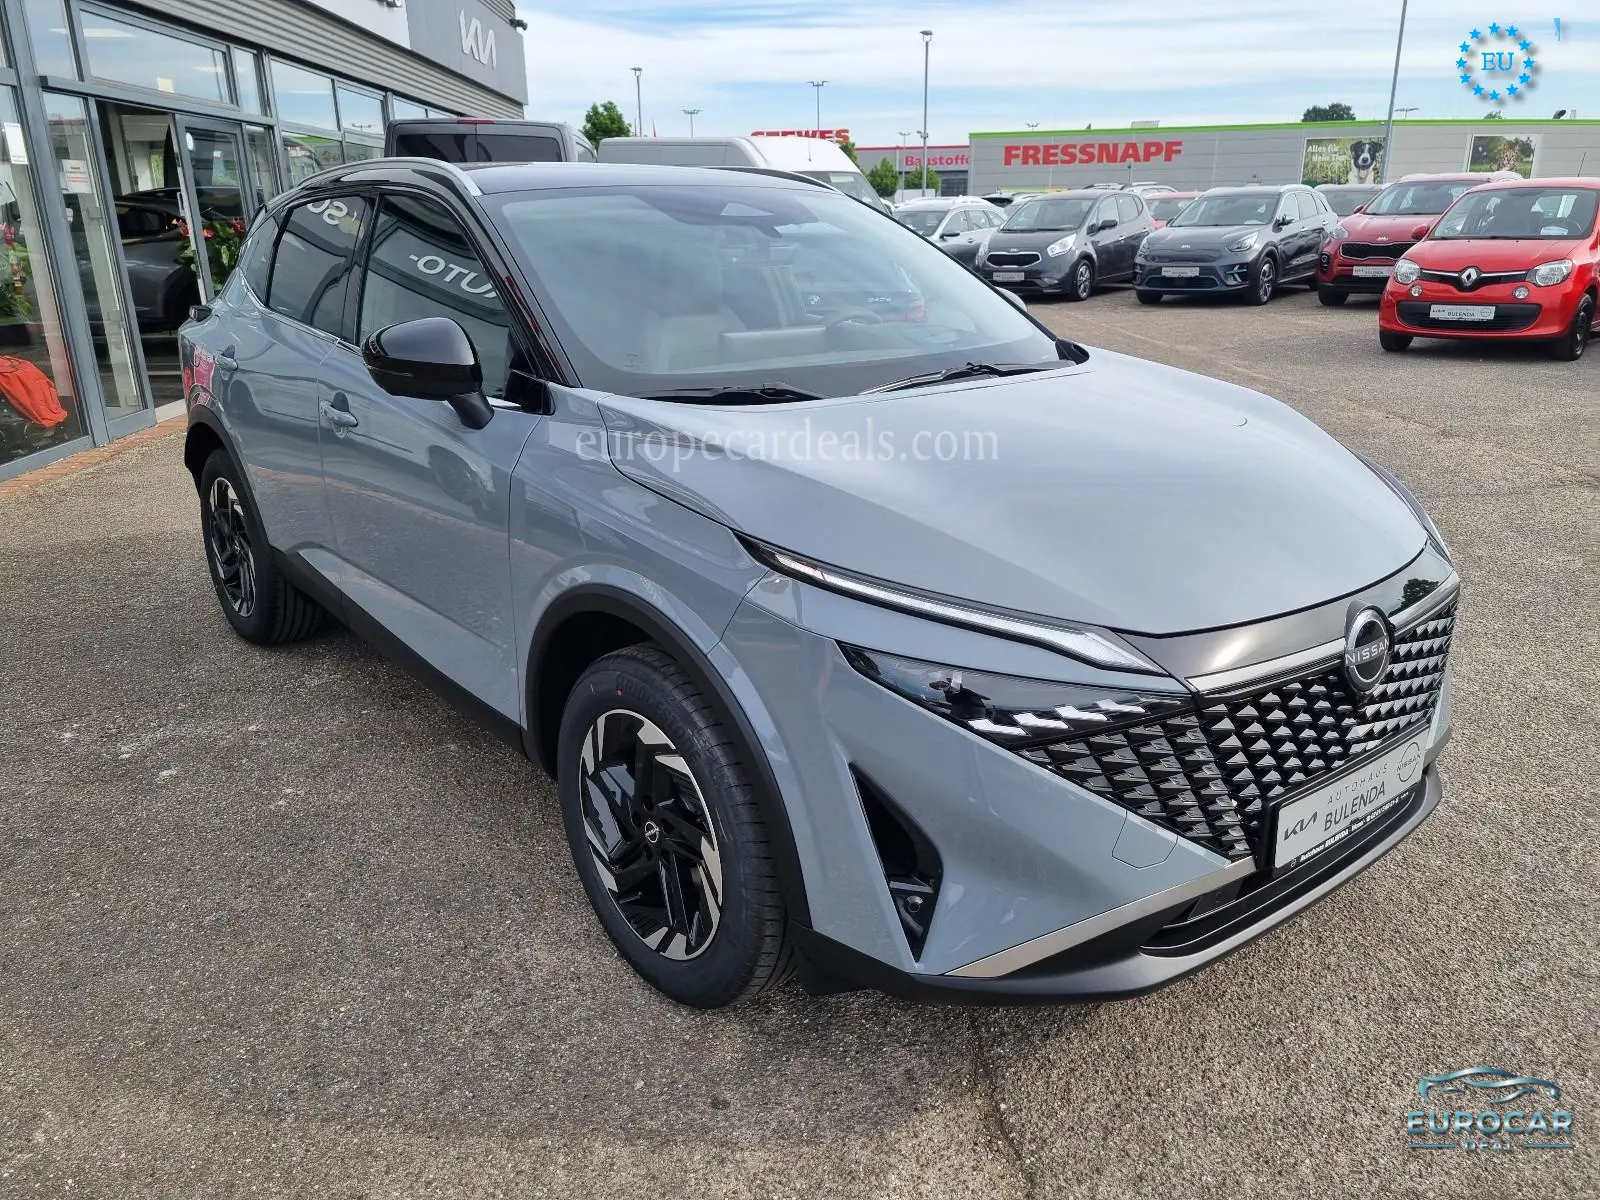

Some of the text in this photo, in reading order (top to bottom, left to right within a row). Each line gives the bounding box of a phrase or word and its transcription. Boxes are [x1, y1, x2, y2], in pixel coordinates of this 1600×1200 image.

[1003, 140, 1183, 167] FRESSNAPF
[1306, 144, 1326, 153] Alles
[1396, 753, 1421, 773] NISSAN
[1327, 762, 1389, 805] AUTOHAUS
[1323, 781, 1386, 832] BULENDA
